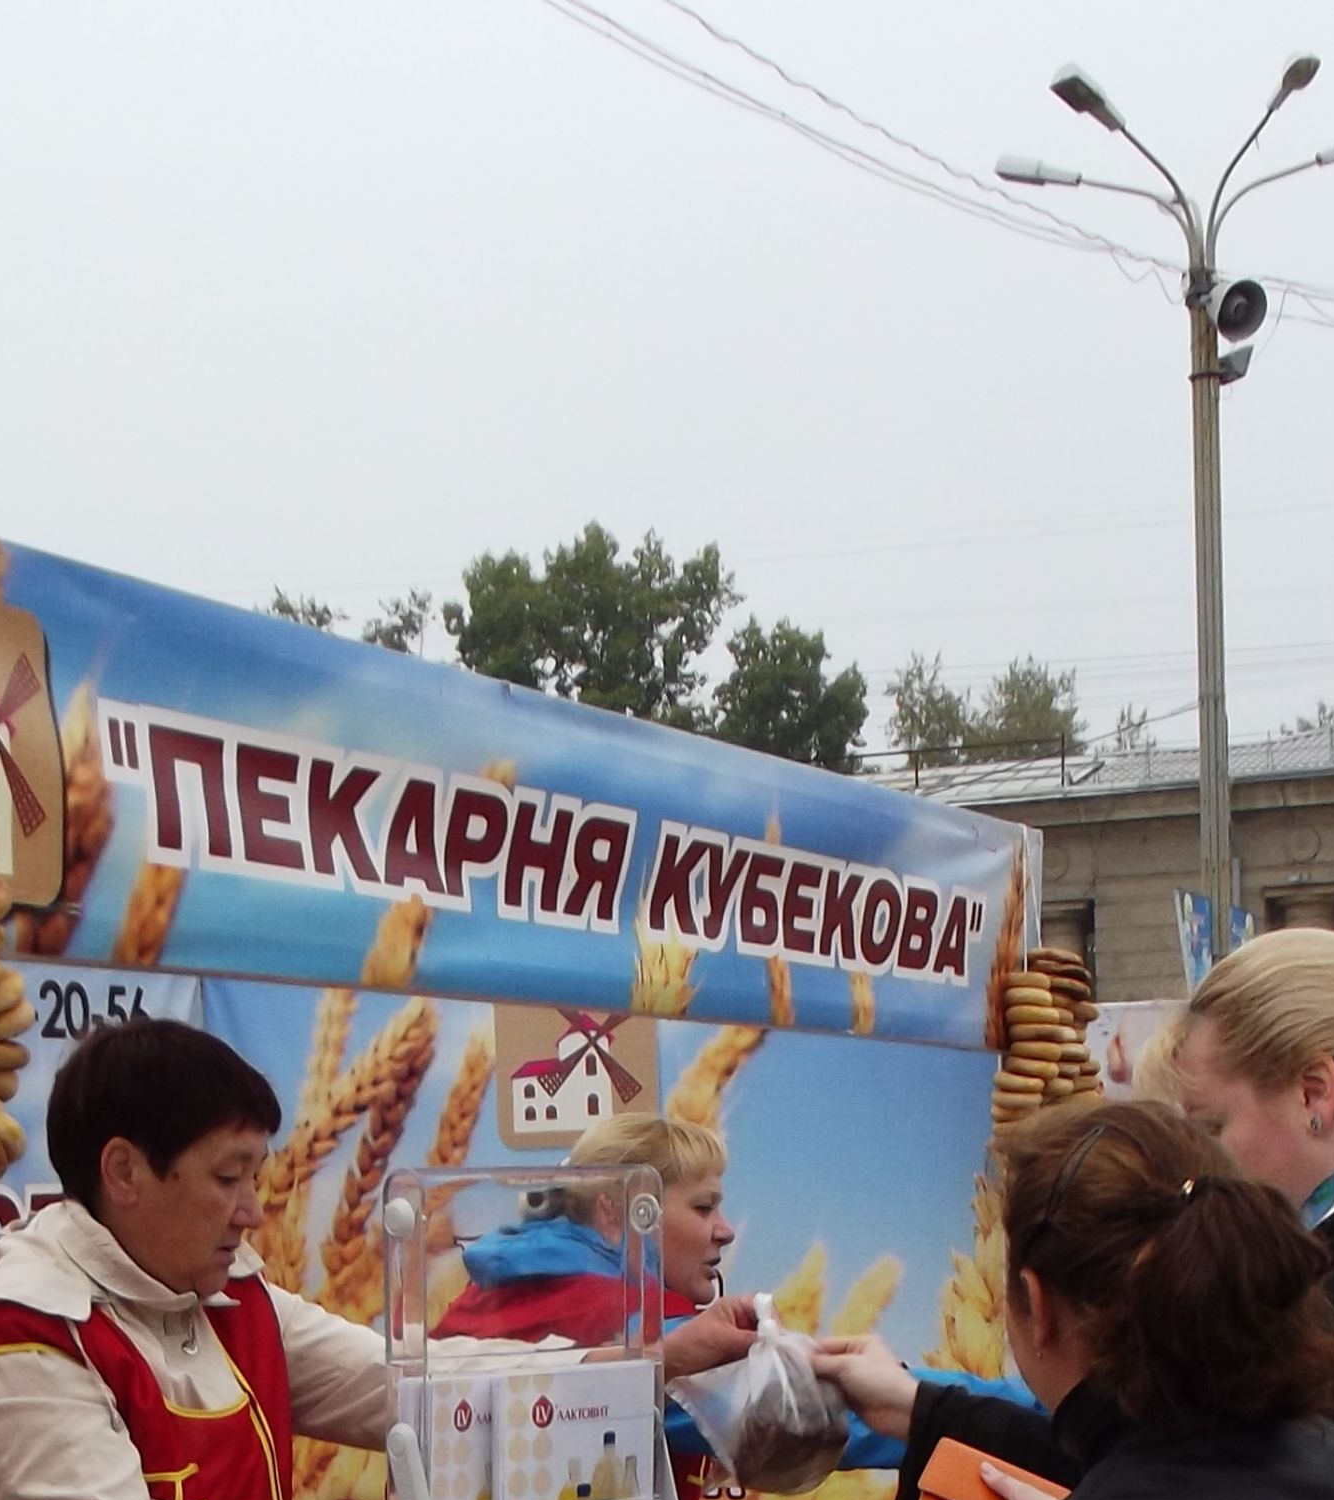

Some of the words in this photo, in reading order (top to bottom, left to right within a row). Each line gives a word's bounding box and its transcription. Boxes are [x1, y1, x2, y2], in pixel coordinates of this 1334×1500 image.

[107, 717, 630, 922] "ПЕКАРНЯ
[649, 833, 983, 977] КУБЕКОВА"
[557, 1406, 609, 1421] ЛАКТОВИТ
